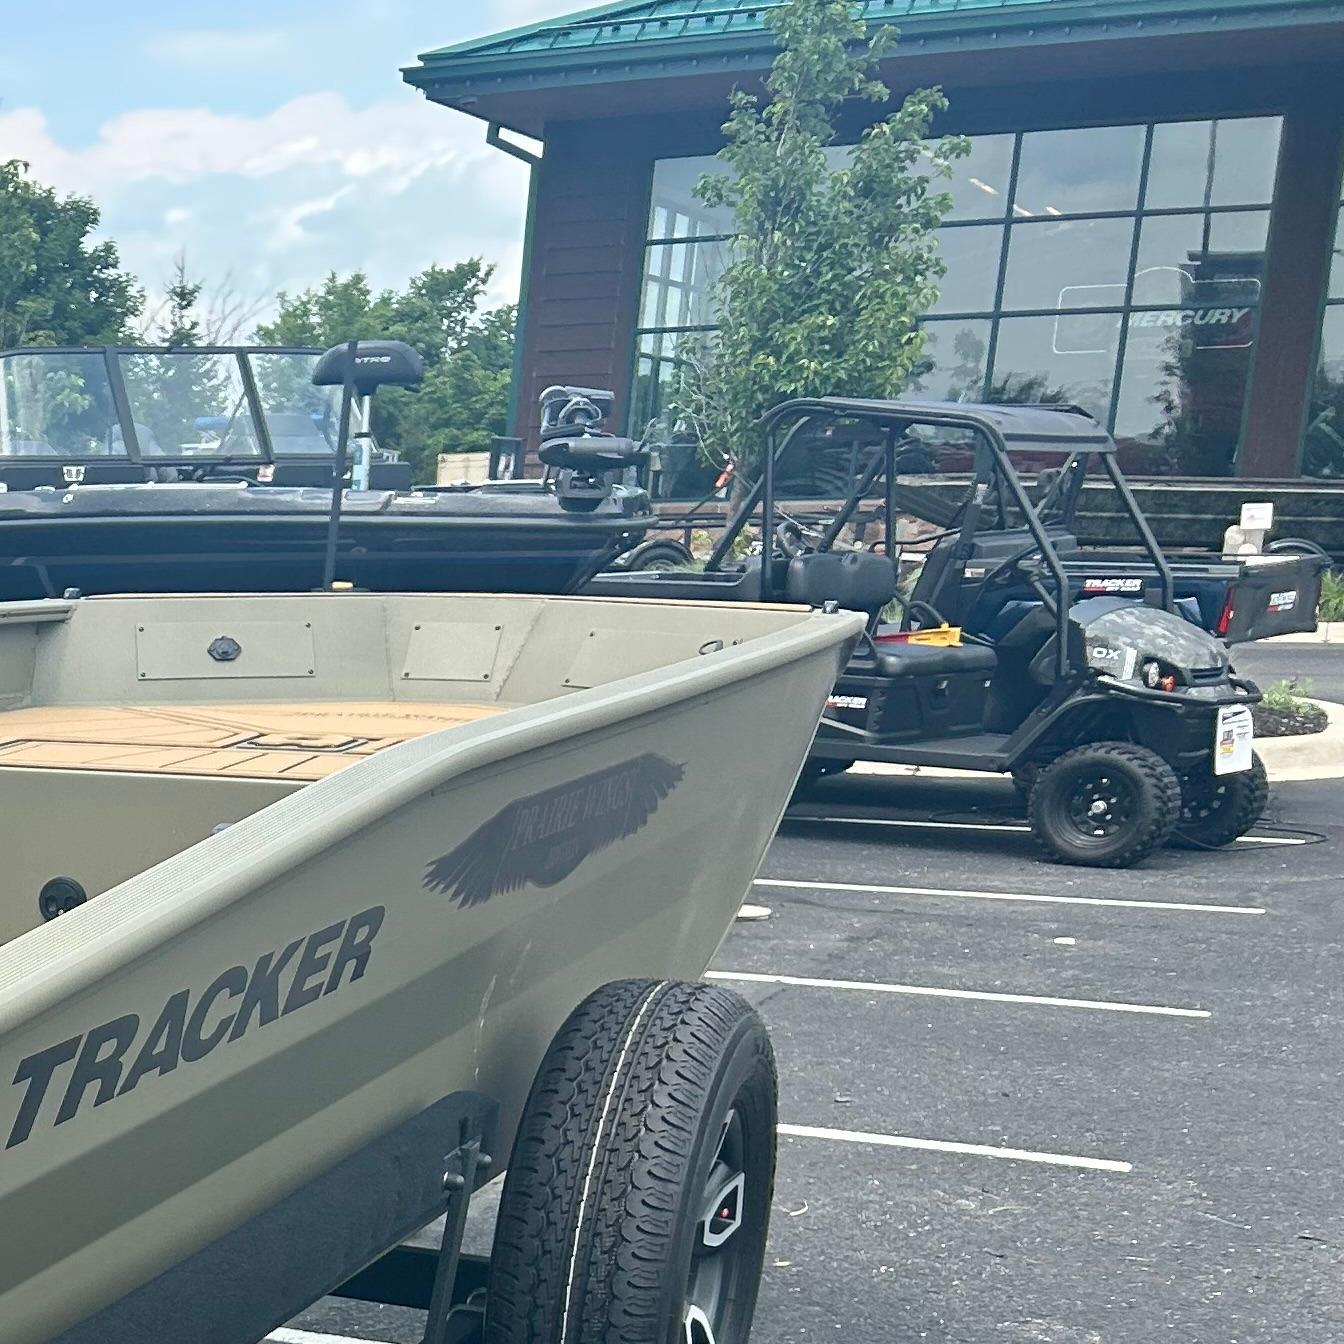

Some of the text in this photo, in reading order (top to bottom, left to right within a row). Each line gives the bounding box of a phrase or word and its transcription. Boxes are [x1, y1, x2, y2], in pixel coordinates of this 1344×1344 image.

[1116, 307, 1250, 329] MERCURY
[1084, 578, 1143, 588] TRACKER
[4, 905, 386, 1151] TRACKER
